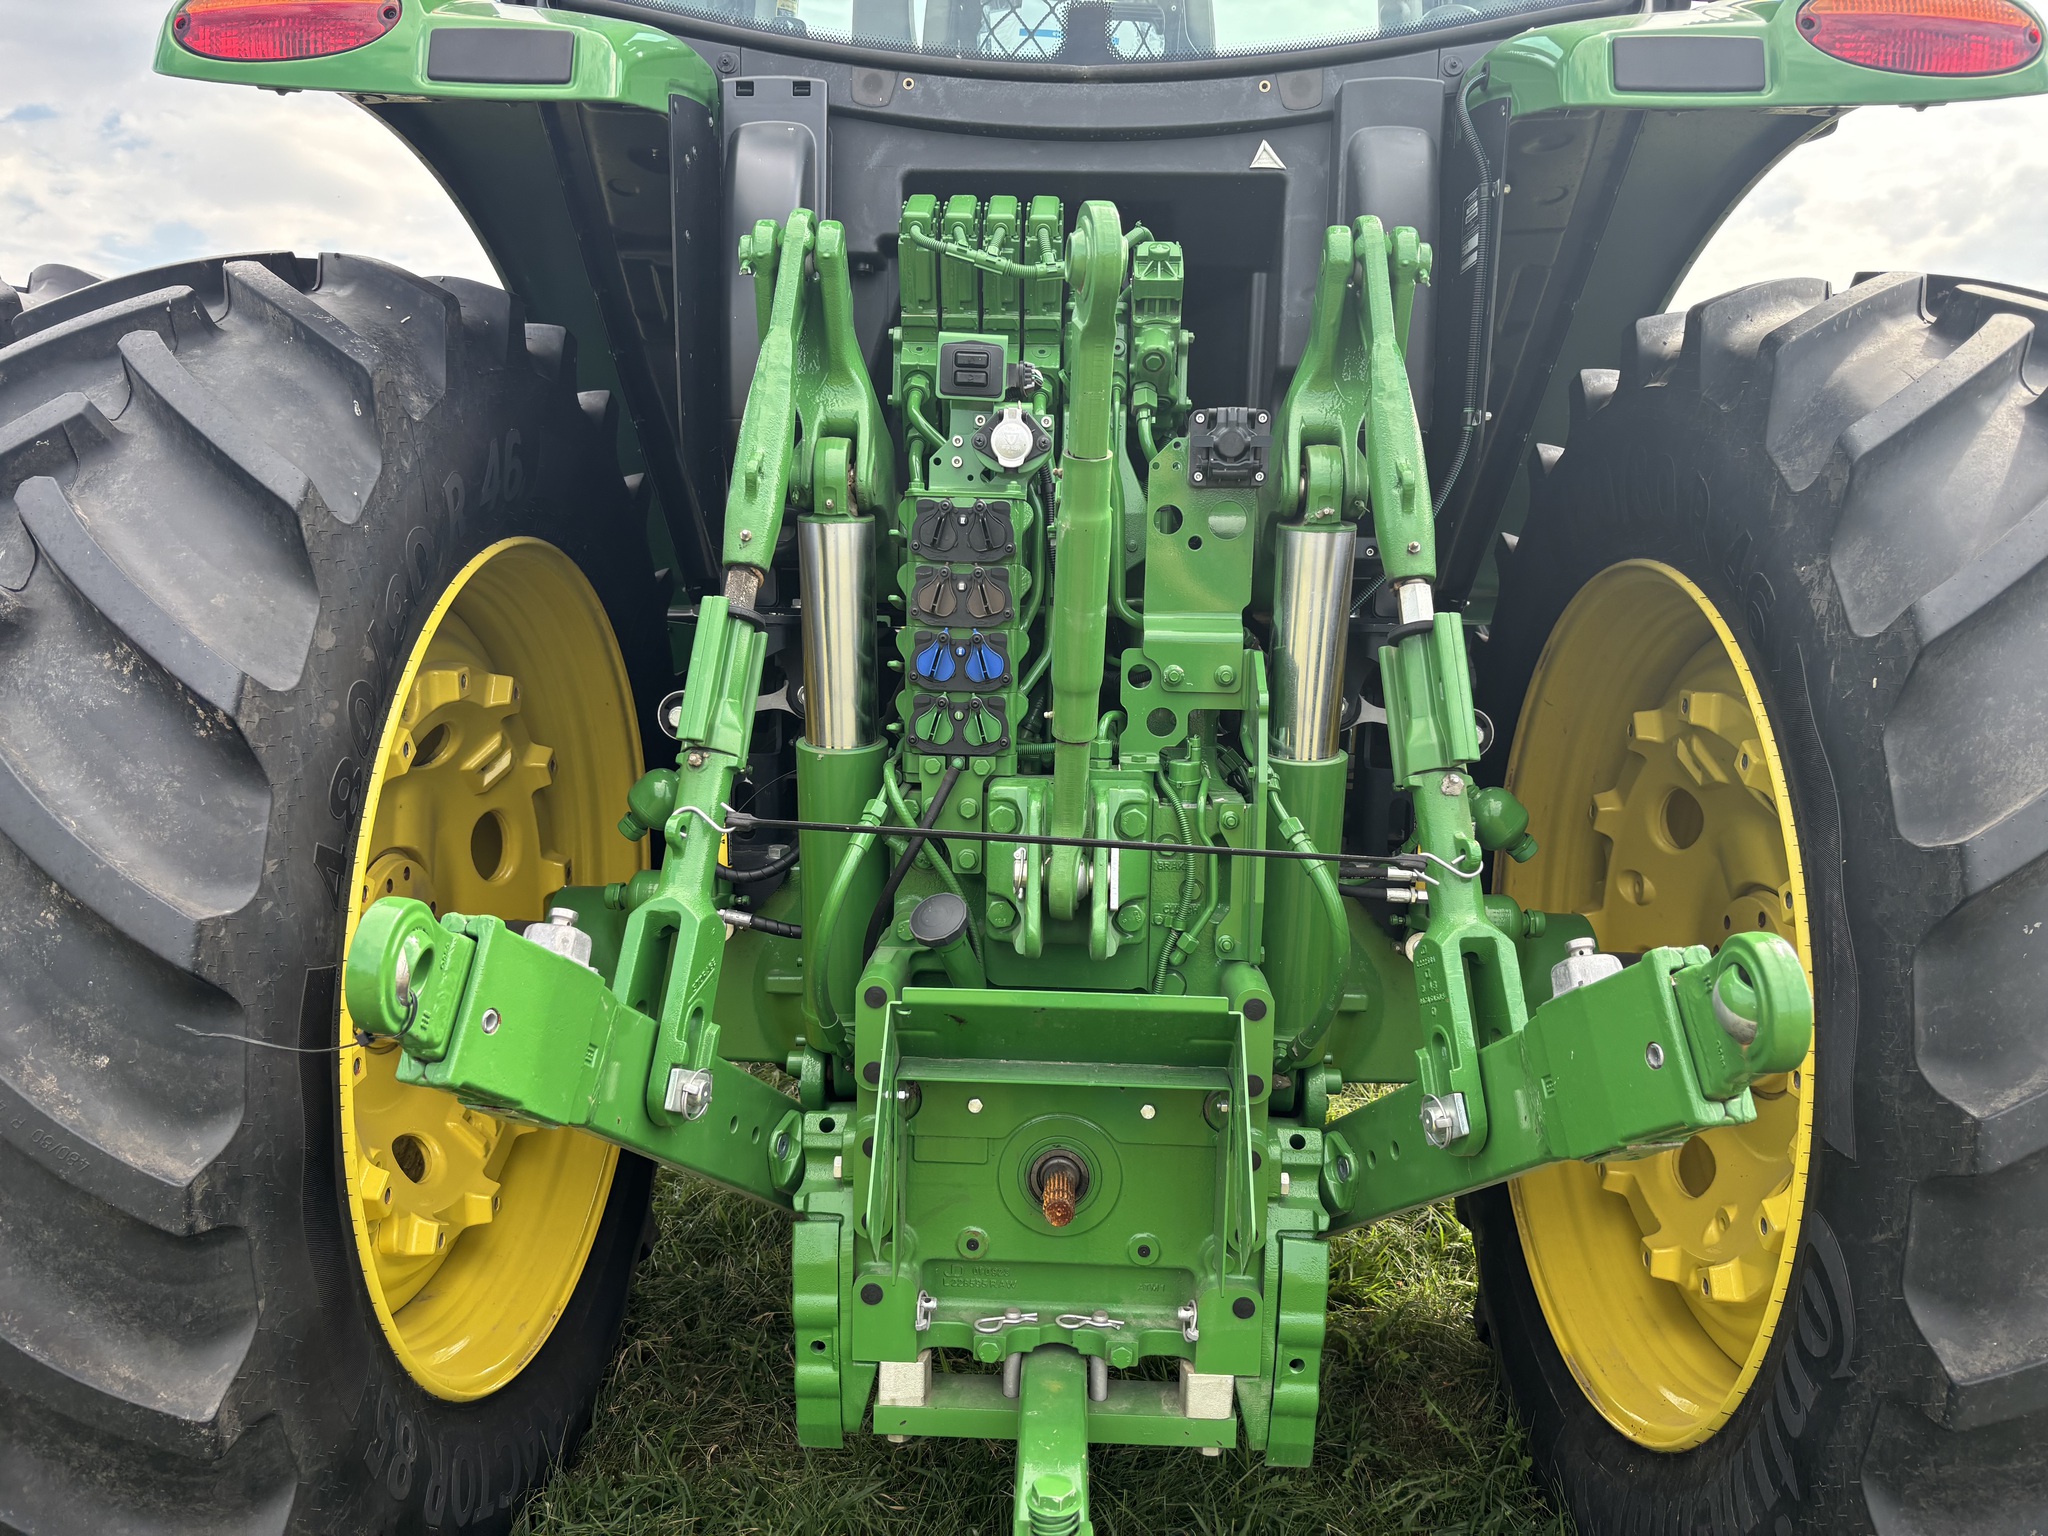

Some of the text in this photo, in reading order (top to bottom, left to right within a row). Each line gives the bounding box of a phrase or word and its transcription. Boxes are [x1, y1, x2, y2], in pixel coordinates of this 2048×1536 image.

[479, 428, 526, 511] 46
[30, 1127, 92, 1173] 480/80
[363, 1383, 418, 1501] 85
